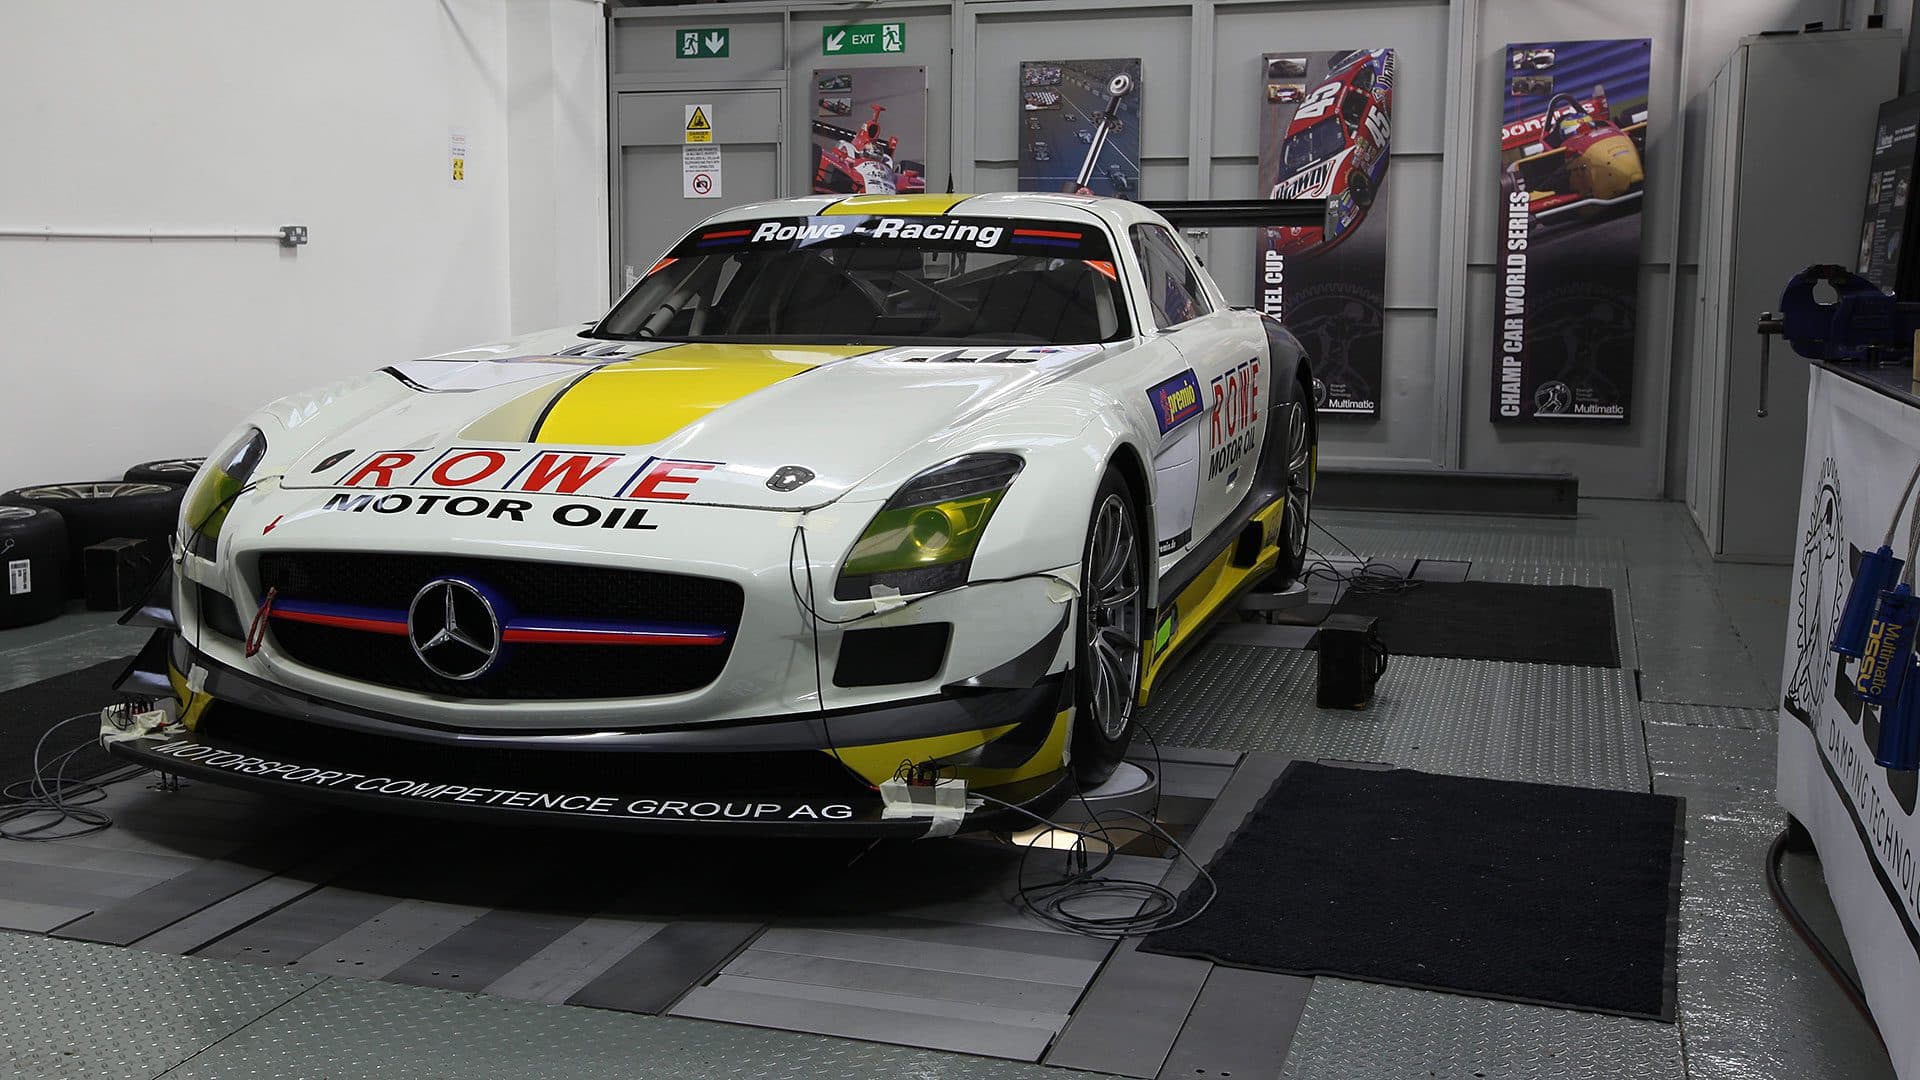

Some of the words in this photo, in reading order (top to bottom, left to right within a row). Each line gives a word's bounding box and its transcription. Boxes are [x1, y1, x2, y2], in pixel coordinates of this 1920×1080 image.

[852, 34, 875, 45] EXIT
[1365, 105, 1392, 149] 45
[751, 222, 845, 242] Rowe
[873, 219, 1003, 247] Racing
[1507, 191, 1530, 251] SERIES
[1265, 250, 1284, 284] CUP
[1505, 254, 1526, 315] WORLD
[1503, 318, 1523, 353] CAR
[1167, 380, 1196, 422] premio
[1211, 363, 1259, 450] ROWE
[1328, 399, 1374, 409] Multimatic
[1500, 356, 1522, 417] CHAMP
[1574, 404, 1624, 414] Multimatic
[344, 451, 715, 500] ROWE
[1208, 434, 1243, 481] MOTOR
[1243, 426, 1255, 455] OIL
[322, 493, 533, 522] MOTOR
[552, 503, 659, 530] OIL
[1871, 622, 1902, 696] Multimatic
[151, 740, 365, 786] MOTORSPORT
[355, 778, 618, 812] COMPETENCE
[627, 800, 781, 818] GROUP
[787, 804, 852, 819] AG
[1828, 718, 1869, 810] DAMPING
